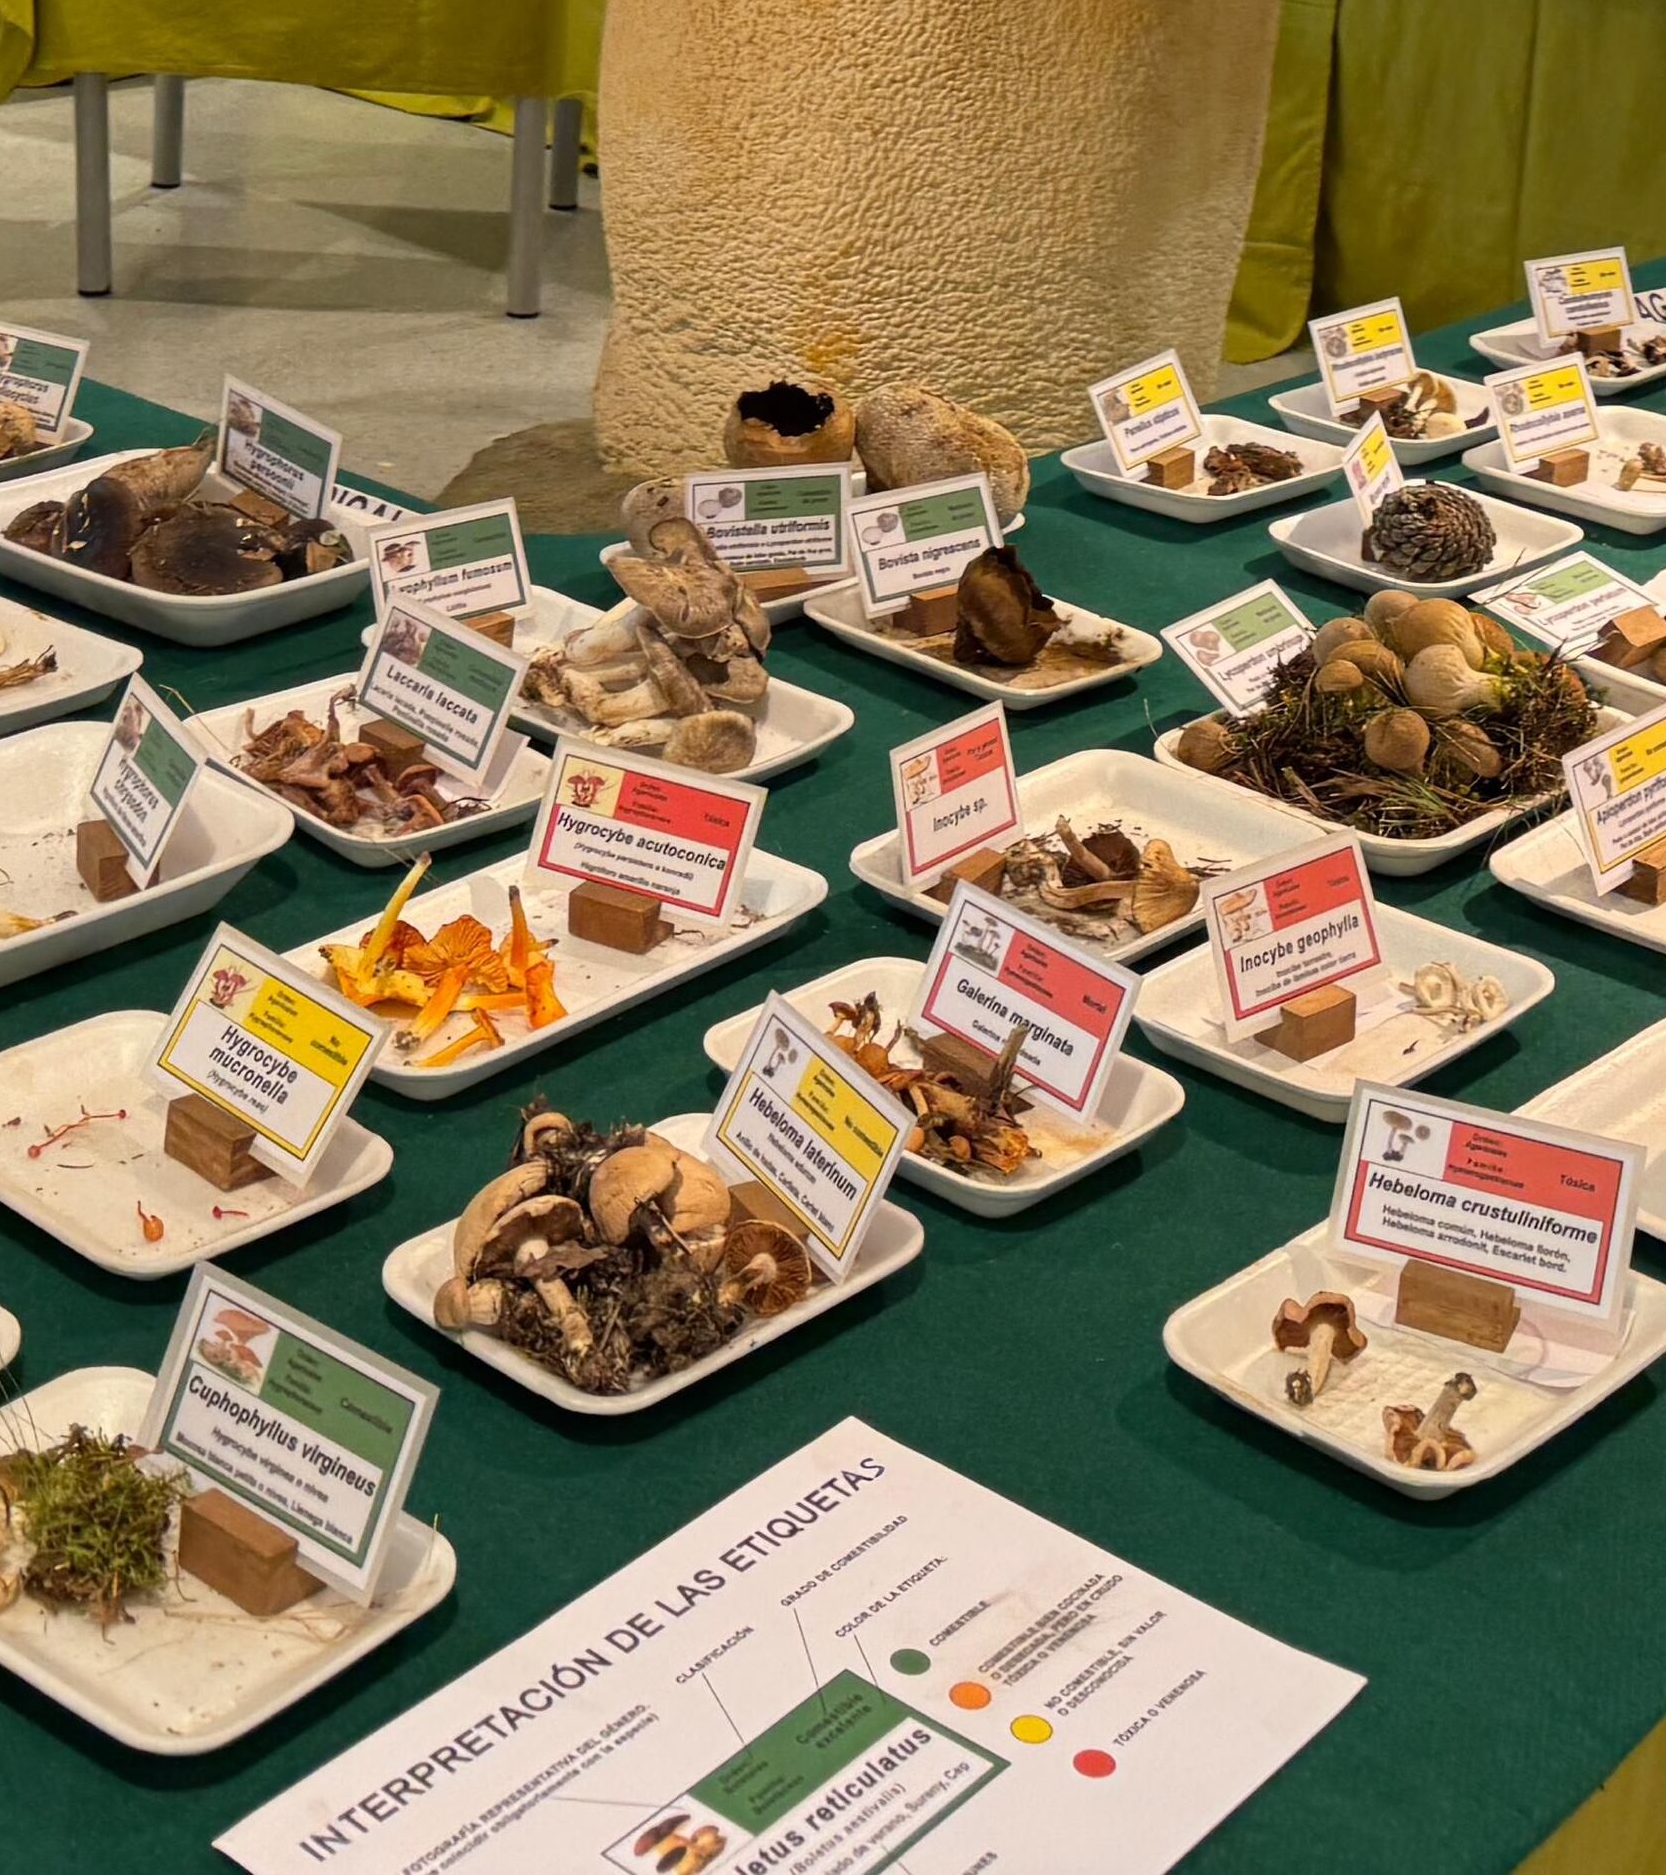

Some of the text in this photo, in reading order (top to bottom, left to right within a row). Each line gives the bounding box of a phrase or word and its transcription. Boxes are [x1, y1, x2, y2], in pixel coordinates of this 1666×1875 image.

[706, 518, 829, 538] Bovistella utriformis
[876, 540, 981, 570] Bovista nigrescens
[392, 573, 459, 597] yophyllum
[385, 663, 478, 726] Laccaria laccata
[556, 810, 727, 871] Hygrocybe acutoconica
[933, 803, 971, 832] Inocybe
[1238, 913, 1360, 972] Inocybe geophylla
[955, 975, 1074, 1058] Galerina marginata
[207, 1045, 289, 1106] mucronella
[220, 1022, 299, 1085] Hygrocybe
[748, 1084, 805, 1151] Hebeloma
[801, 1136, 857, 1203] laterinum
[1367, 1170, 1598, 1245] Hebeloma crustuliniforme
[1558, 1172, 1596, 1193] Tóxica
[1380, 1215, 1436, 1239] Hebeloma
[1381, 1202, 1435, 1227] Hebeloma
[1436, 1218, 1477, 1238] común,
[1478, 1227, 1534, 1253] Hebeloma
[186, 1371, 377, 1497] Cuphophyllus virgineus
[210, 1425, 259, 1462] Hygrocybe
[777, 1513, 911, 1608] GRADO DE COMESTIBILIDAD
[831, 1555, 951, 1638] COLOR DE LA ETIQUETA:
[1032, 1607, 1062, 1629] BIEN
[1048, 1608, 1082, 1633] PERO
[1073, 1599, 1095, 1612] EN
[1086, 1572, 1126, 1602] CRUDO
[671, 1624, 756, 1685] CLASIFICACIÓN
[937, 1604, 1004, 1652] COMESTIBLE
[291, 1455, 892, 1864] INTERPRETACIÓN DE LAS ETIQUETAS
[1041, 1693, 1065, 1710] NO
[1131, 1609, 1168, 1636] VALOR
[793, 1693, 867, 1746] Comestible
[1054, 1706, 1073, 1717] O
[1111, 1667, 1208, 1747] TÓXICA O VENENOSA
[476, 1752, 579, 1823] REPRESENTATIVA
[803, 1729, 937, 1831] reticulatus
